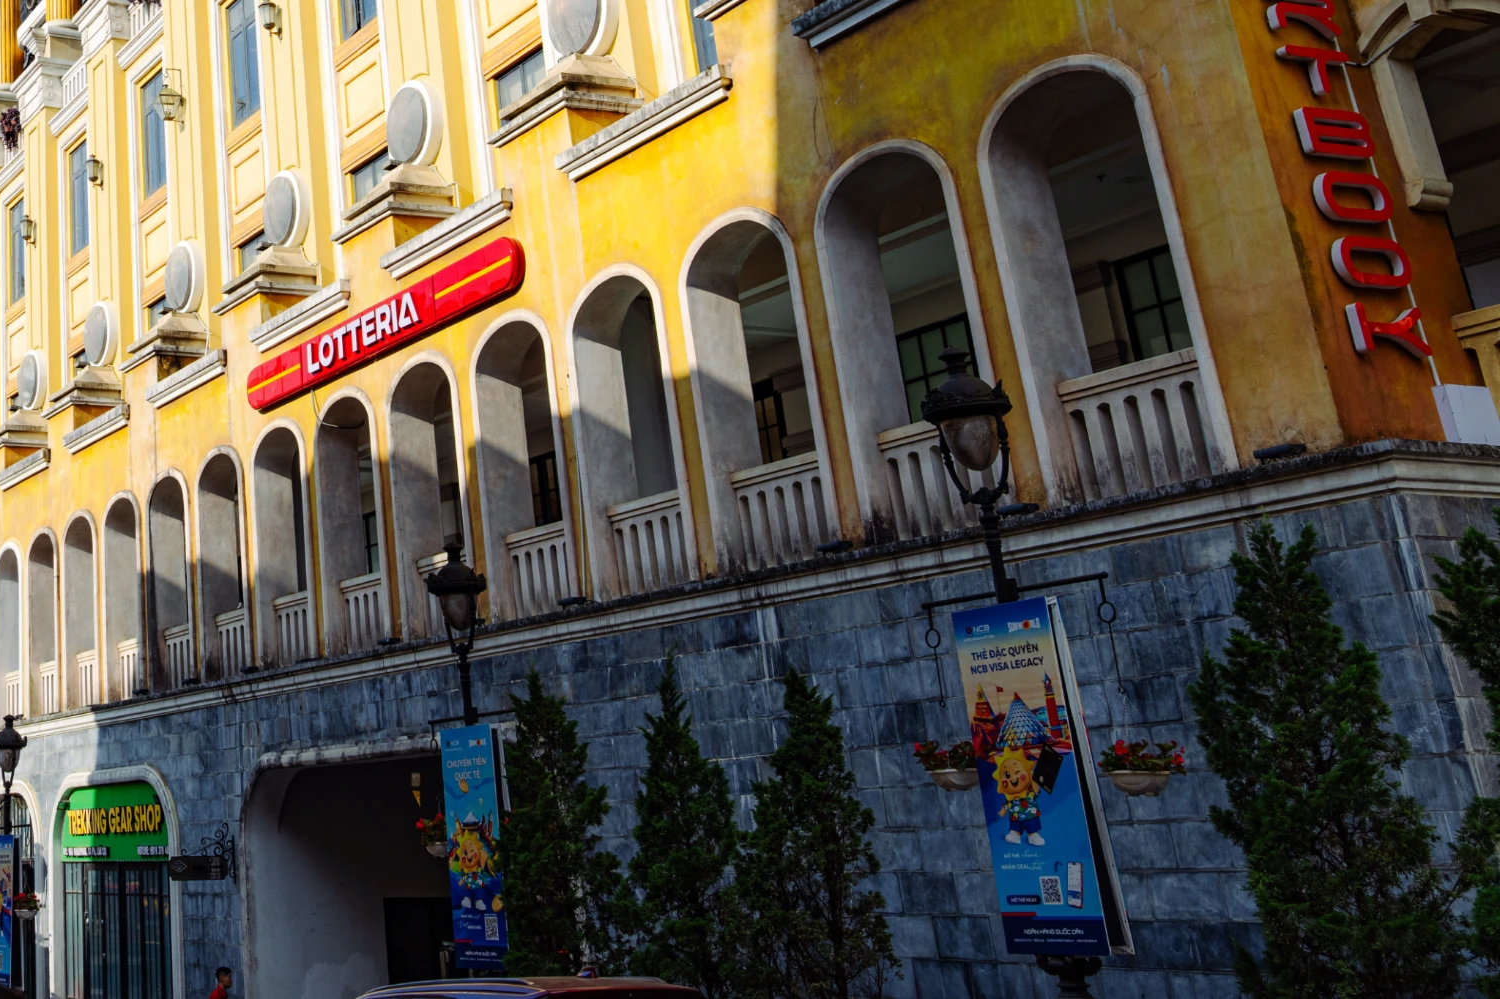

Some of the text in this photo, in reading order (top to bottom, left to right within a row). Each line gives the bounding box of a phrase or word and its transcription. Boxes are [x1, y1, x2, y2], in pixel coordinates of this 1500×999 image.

[1292, 105, 1434, 361] BOOK
[305, 291, 420, 375] LOTTERIA
[973, 624, 990, 634] NCB
[971, 641, 1039, 661] THẺ ĐẶC QUYỀN
[970, 656, 1044, 675] NCB VISA LEGACY
[67, 803, 162, 835] TREKKING GEAR SHOP
